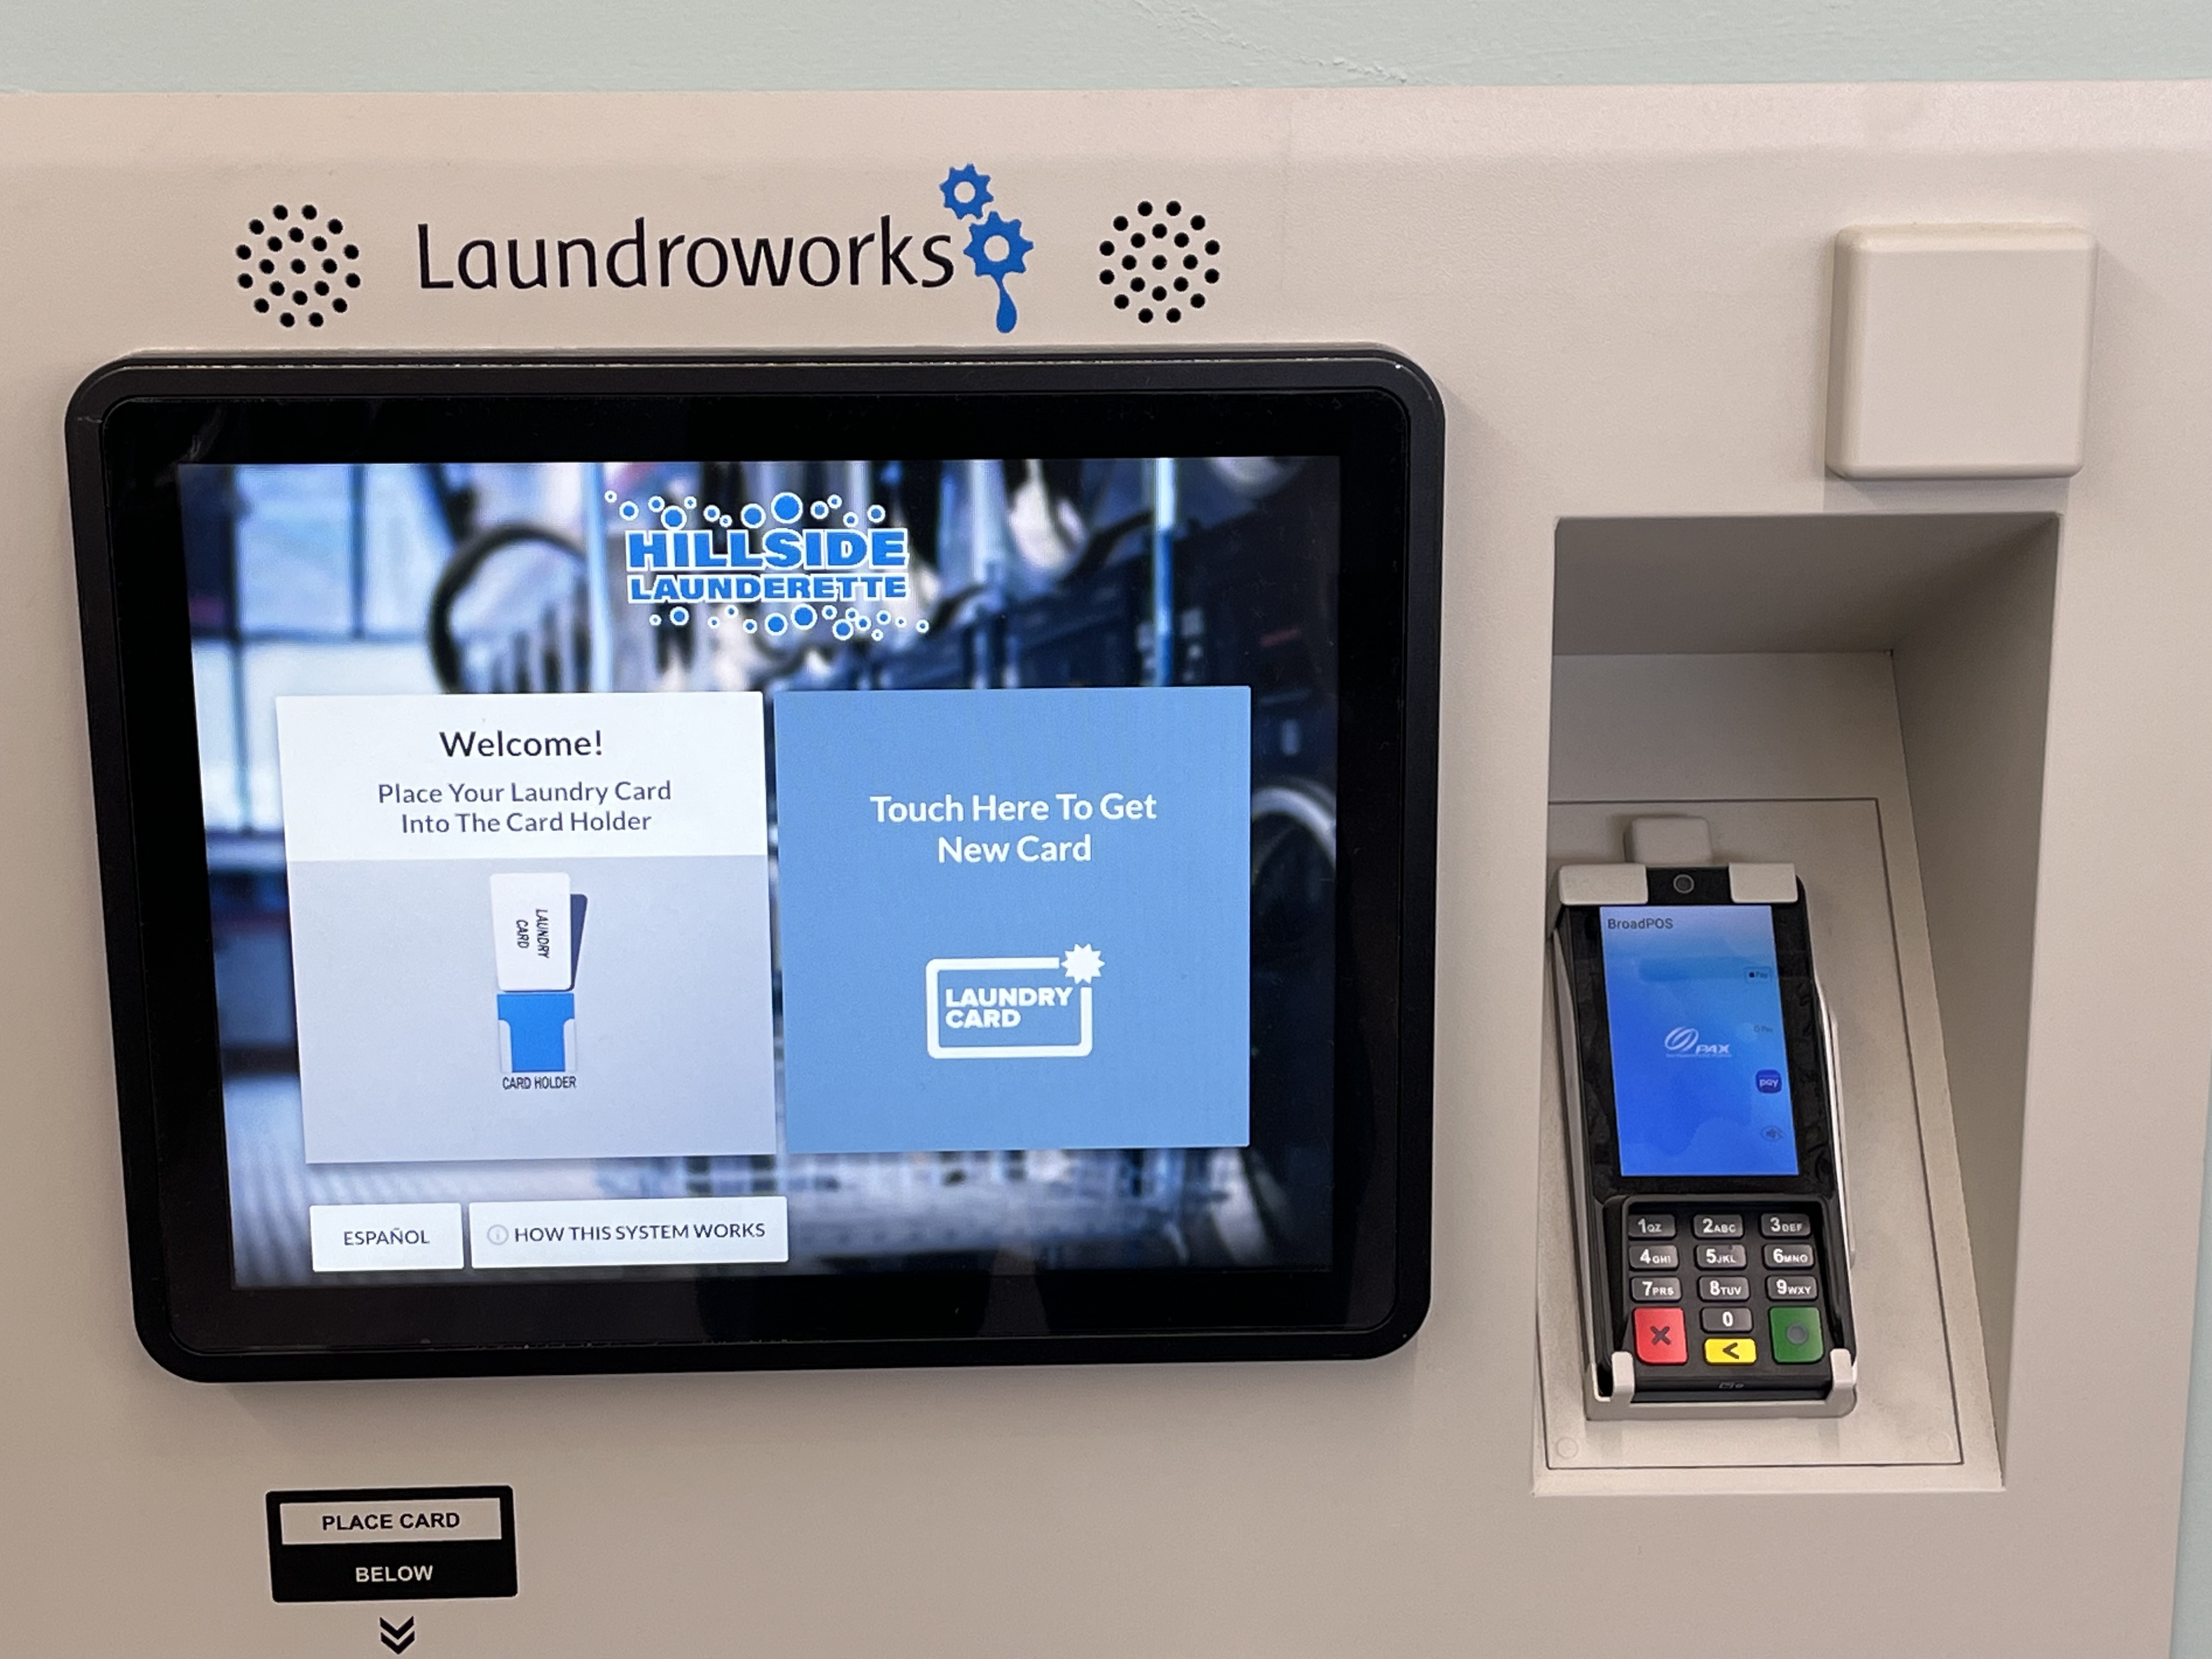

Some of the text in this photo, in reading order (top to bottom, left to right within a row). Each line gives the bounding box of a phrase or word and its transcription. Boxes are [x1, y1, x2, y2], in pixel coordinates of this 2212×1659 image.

[417, 215, 955, 289] Laundroworks
[626, 529, 909, 571] HILLSIDE
[628, 573, 909, 603] LAUNDERETTE
[439, 730, 603, 757] Welcome!
[379, 780, 672, 805] Place Your Laundry Card
[870, 793, 1157, 822] Touch Here To Get
[402, 811, 652, 833] Into The Card Holder
[938, 833, 1092, 863] New Card
[516, 919, 529, 949] CARD
[535, 909, 550, 958] LAUNDRY
[1607, 918, 1673, 930] BroadPOS
[945, 986, 1074, 1007] LAUNDRY
[945, 1008, 1021, 1028] CARD
[1695, 1043, 1730, 1054] PAX
[503, 1075, 577, 1090] CARD HOLDER
[343, 1227, 431, 1246] ESPAÑOL
[514, 1223, 766, 1243] HOW THIS SYSTEM WORKS
[1722, 1311, 1734, 1327] 0
[322, 1513, 460, 1530] PLACE CARD
[356, 1565, 433, 1582] BELOW
